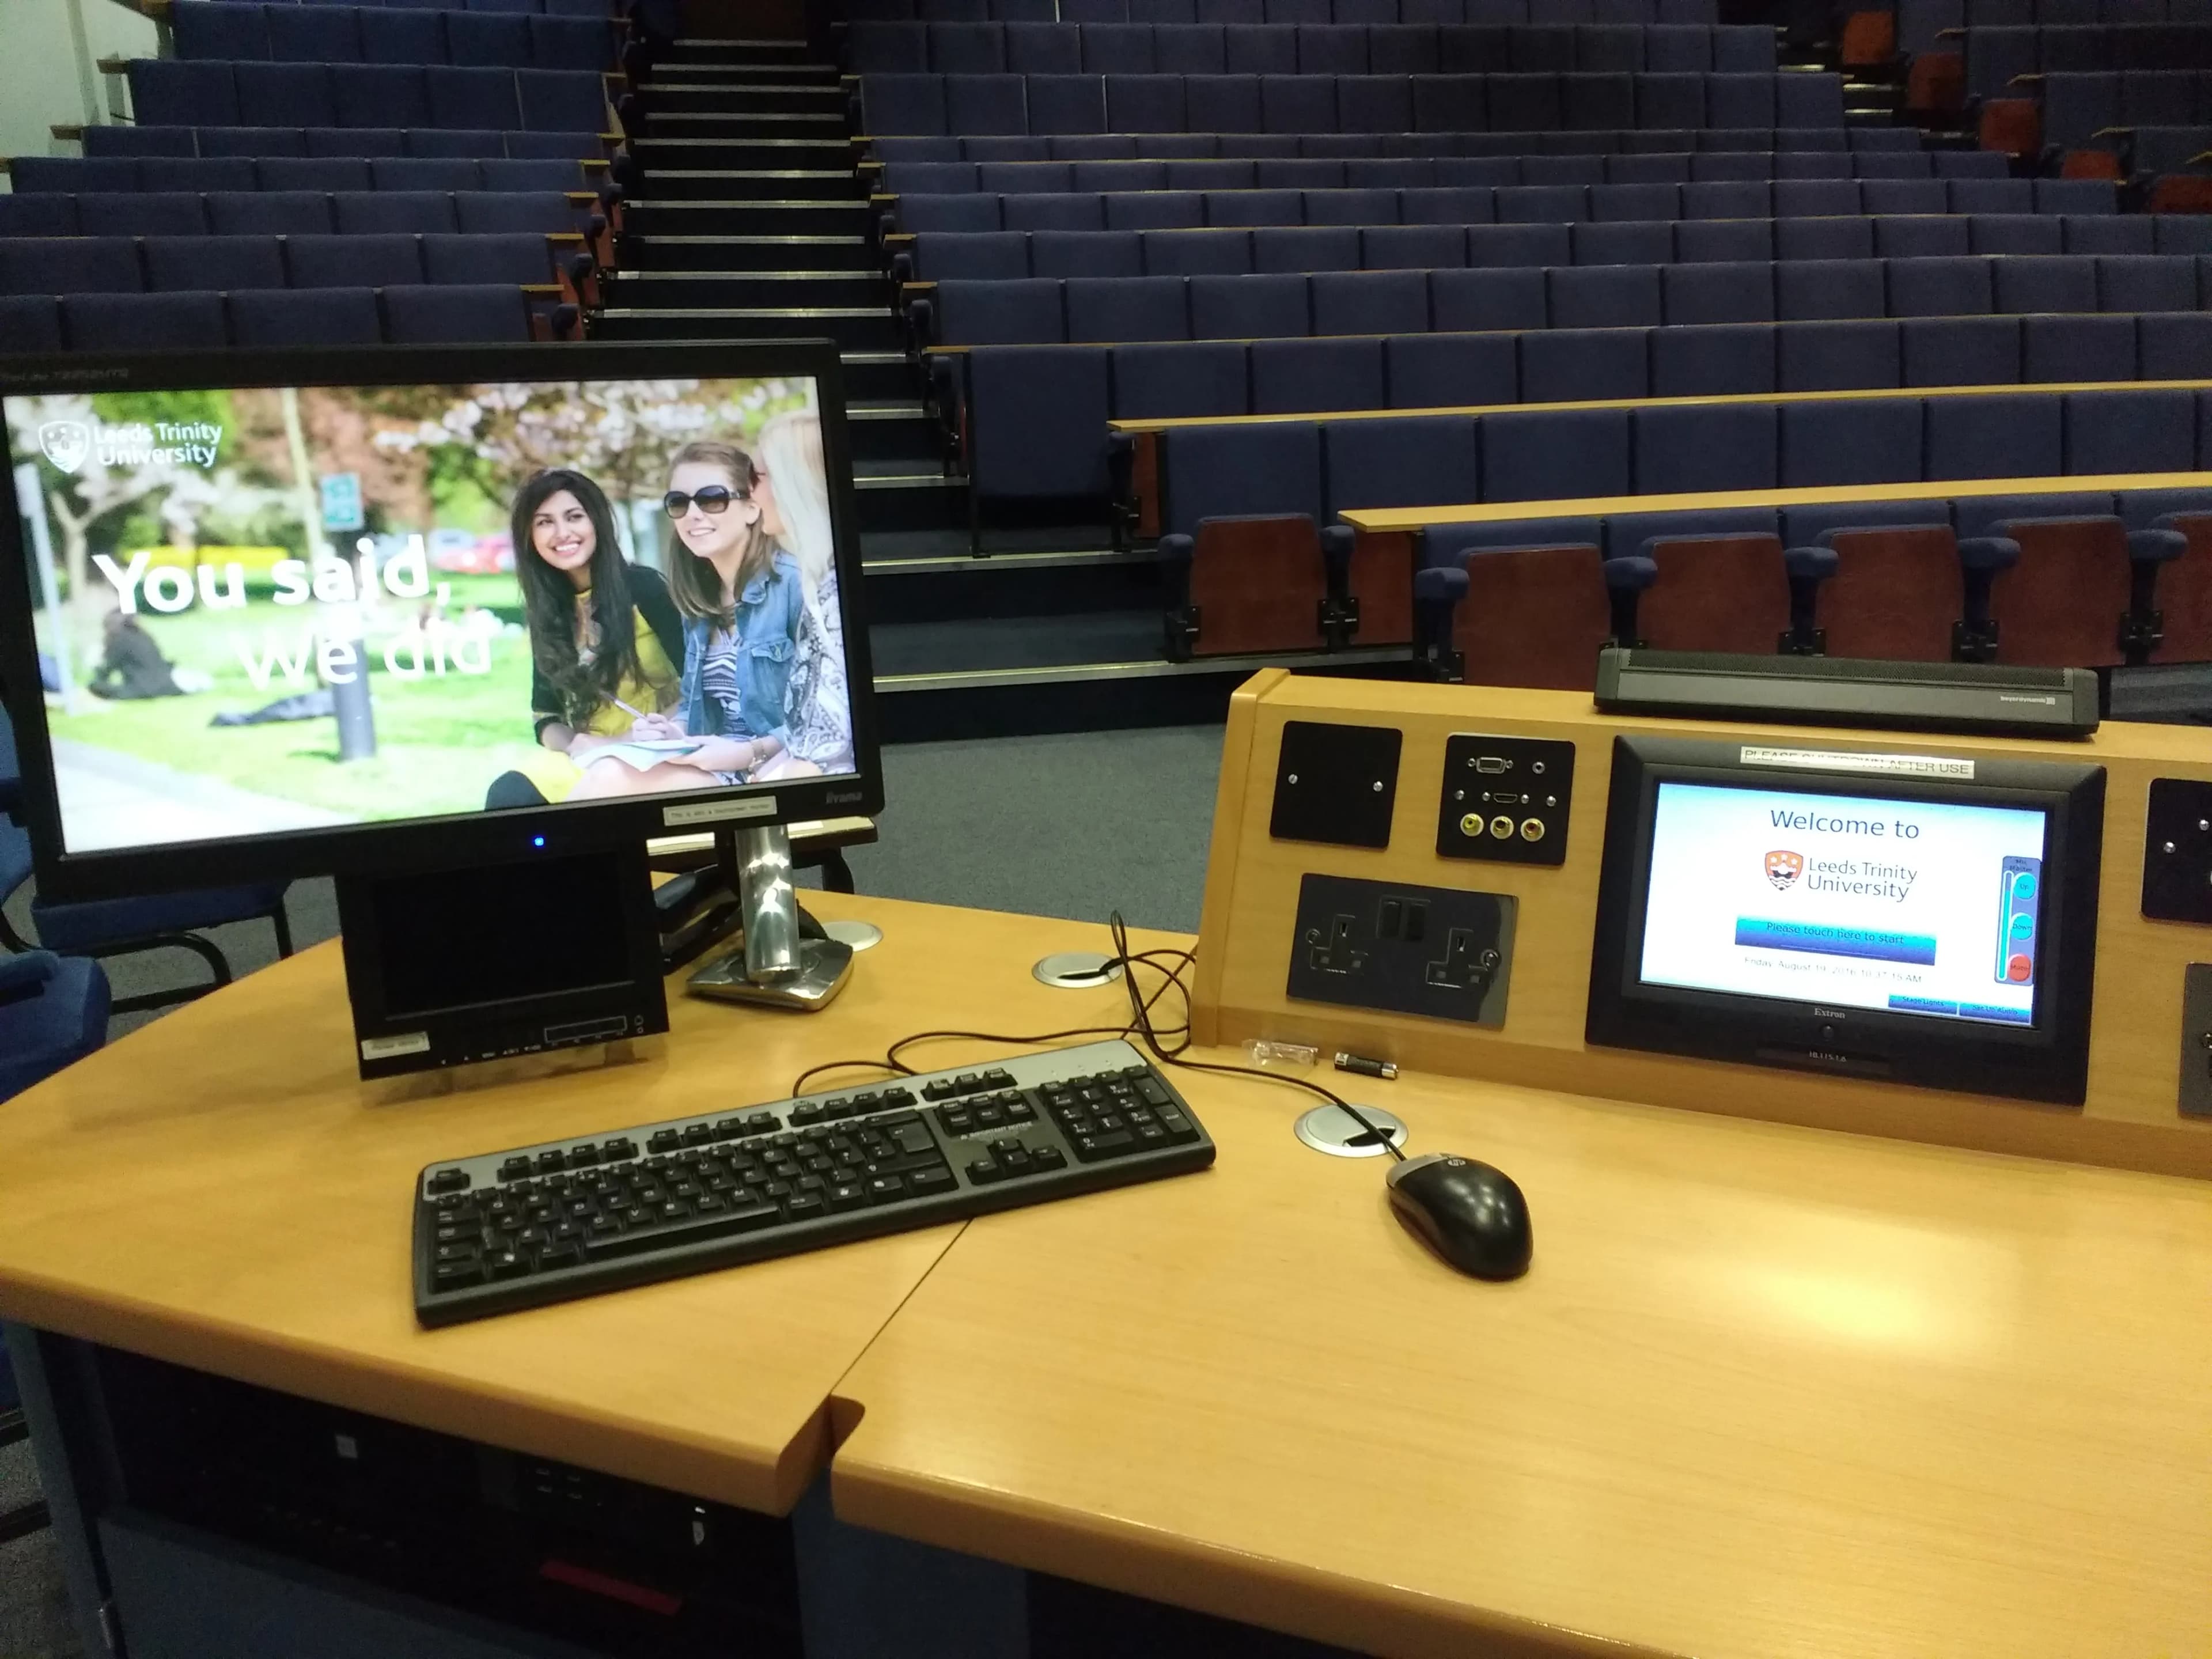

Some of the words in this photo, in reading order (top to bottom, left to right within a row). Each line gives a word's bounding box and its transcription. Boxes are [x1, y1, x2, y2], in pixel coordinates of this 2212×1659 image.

[93, 422, 153, 444] Leeds
[154, 421, 223, 445] Trinity
[97, 442, 217, 468] University
[90, 550, 247, 615] You
[272, 533, 452, 607] said,
[384, 608, 492, 680] did
[1939, 763, 1970, 774] USE
[1770, 809, 1885, 836] Welcome
[1895, 820, 1919, 839] to
[1809, 857, 1857, 874] Leeds
[1861, 862, 1918, 884] Trinity
[1808, 874, 1909, 903] University
[1767, 922, 1801, 934] Please
[1804, 925, 1834, 937] touch
[1837, 927, 1861, 941] here
[1865, 932, 1875, 941] to
[1878, 933, 1904, 945] start
[1778, 960, 1810, 972] August
[1906, 974, 1922, 983] AM
[1814, 1007, 1846, 1019] Extron
